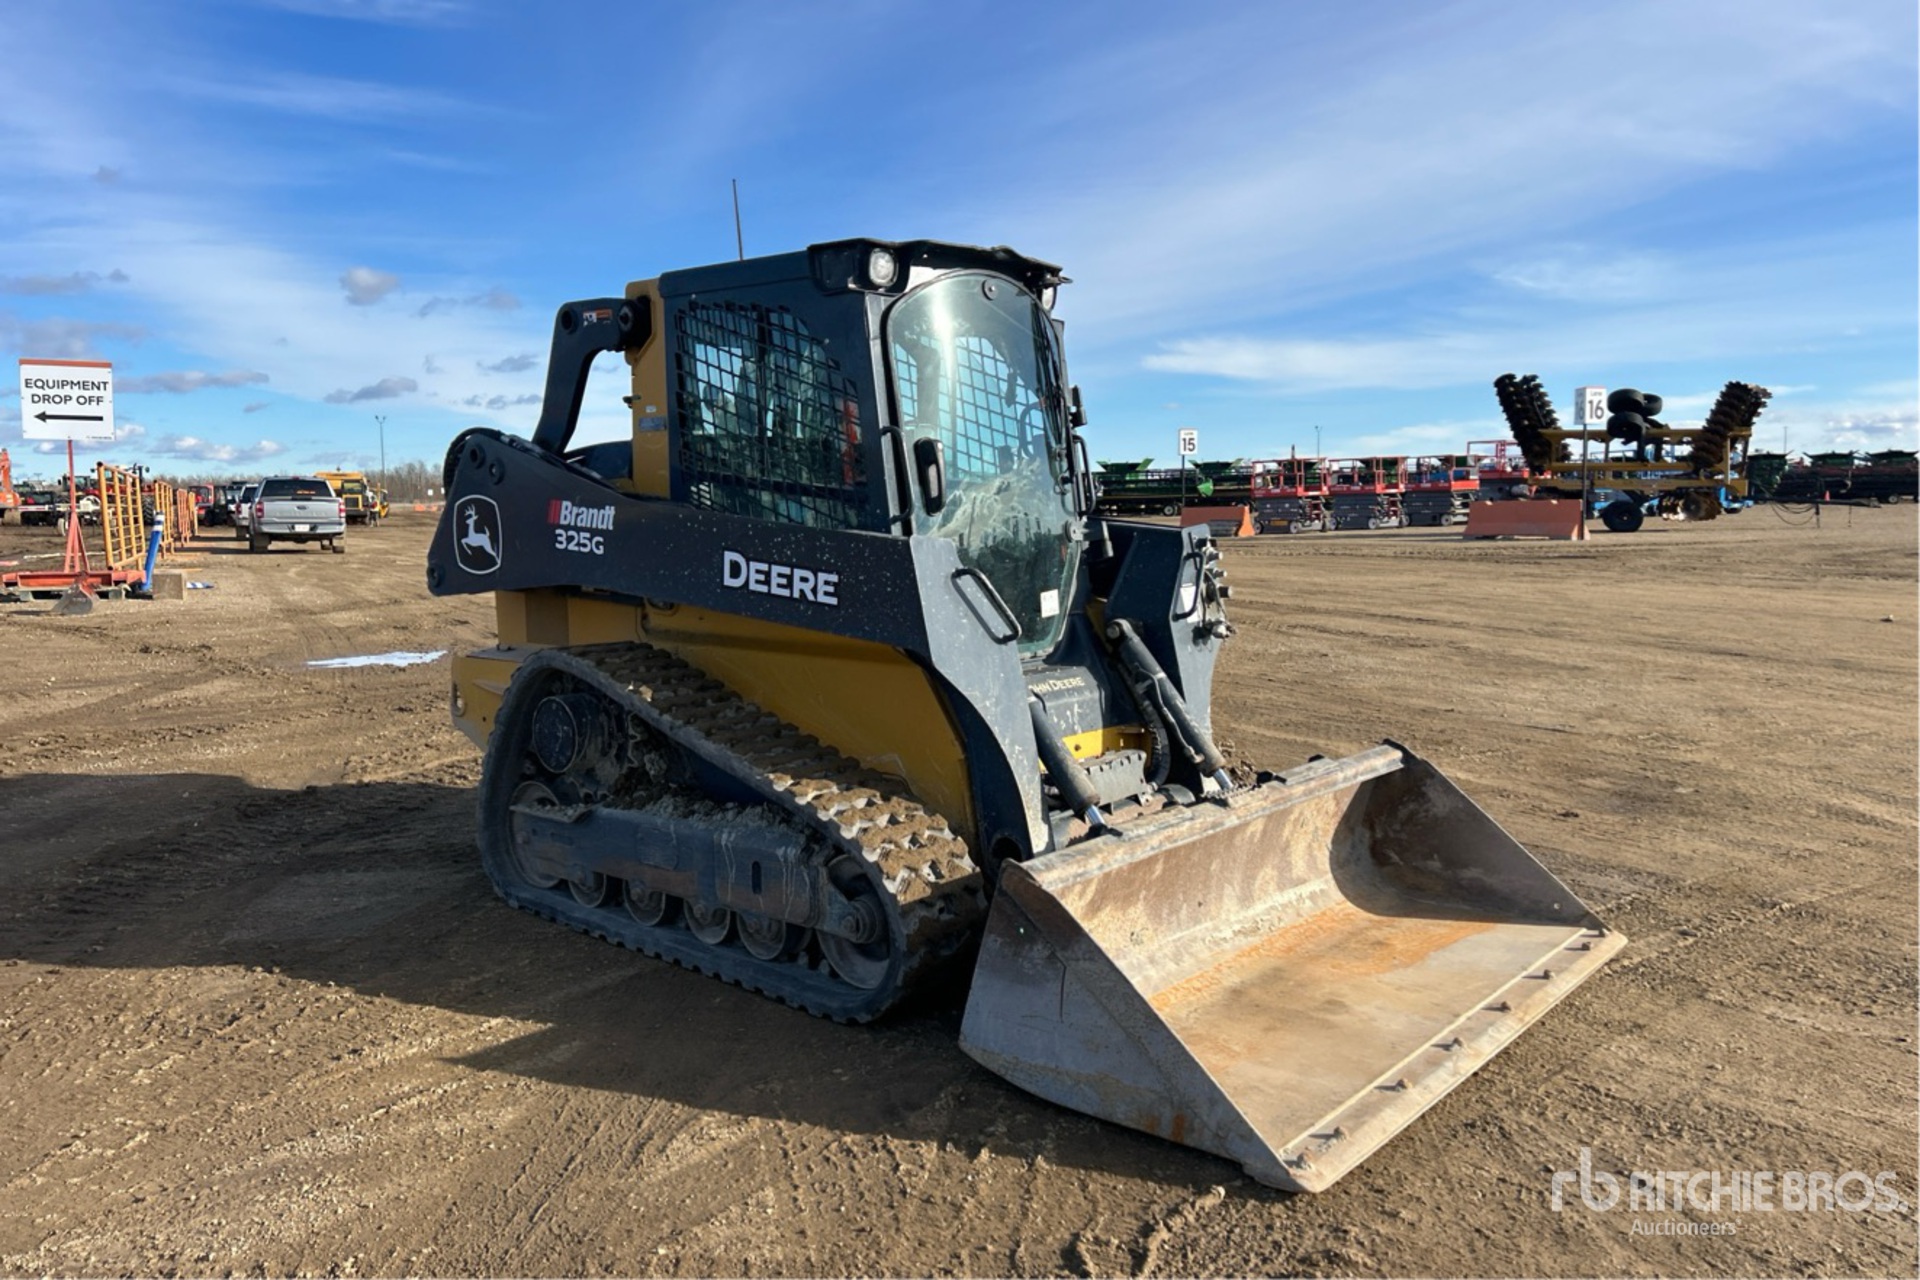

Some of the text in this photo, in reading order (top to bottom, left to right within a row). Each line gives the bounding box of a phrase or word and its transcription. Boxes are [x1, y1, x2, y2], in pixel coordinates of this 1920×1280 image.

[25, 378, 109, 391] EQUIPMENT
[31, 393, 104, 406] DROP OFF
[1588, 400, 1605, 420] 16
[1182, 437, 1196, 452] 15
[559, 500, 616, 531] Brandt
[555, 528, 605, 555] 325G
[722, 550, 840, 606] DEERE
[1049, 677, 1085, 691] DEERE
